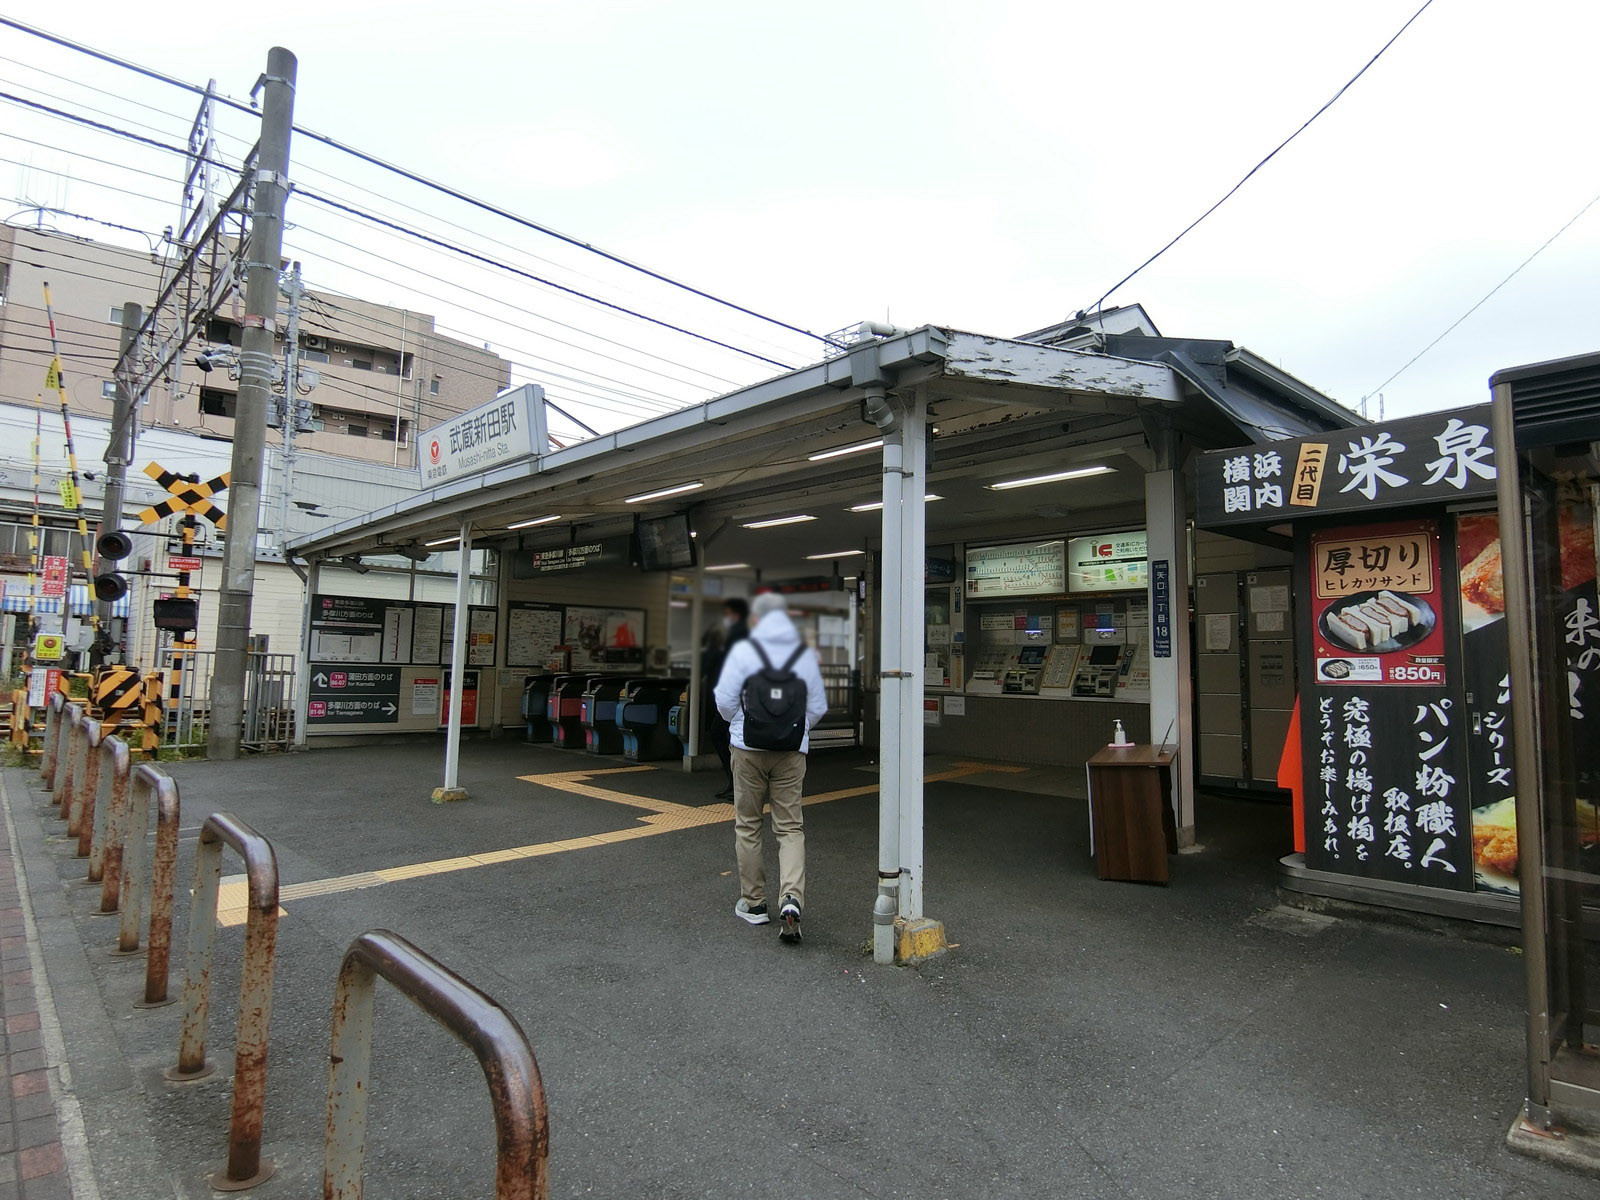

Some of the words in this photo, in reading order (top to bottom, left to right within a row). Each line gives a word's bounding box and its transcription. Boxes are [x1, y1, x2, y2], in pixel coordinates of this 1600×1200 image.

[449, 401, 517, 455] 武蔵新田駅
[458, 447, 497, 469] Musashi-nitta
[497, 442, 511, 457] Sta.
[1223, 450, 1282, 484] 横浜
[1337, 417, 1497, 501] 栄泉
[1296, 448, 1323, 501] 二代目
[1224, 482, 1283, 513] 関内
[1323, 541, 1421, 576] 厚切り
[1156, 571, 1166, 623] 矢口一丁目
[1325, 572, 1422, 591] ヒレカツサンド
[322, 609, 374, 619] 多摩川方面のりば
[1156, 626, 1168, 638] 18
[348, 672, 394, 681] 蒲田方面のりば
[1394, 666, 1441, 681] 850円
[327, 701, 381, 710] 多摩川方面のりば
[1483, 710, 1512, 787] シリーズ
[1319, 696, 1340, 860] どうぞお楽しみあれ。
[1342, 696, 1376, 862] 究極の揚げ物を
[1413, 698, 1457, 873] パン粉職人
[1382, 787, 1412, 869] 取扱店。
